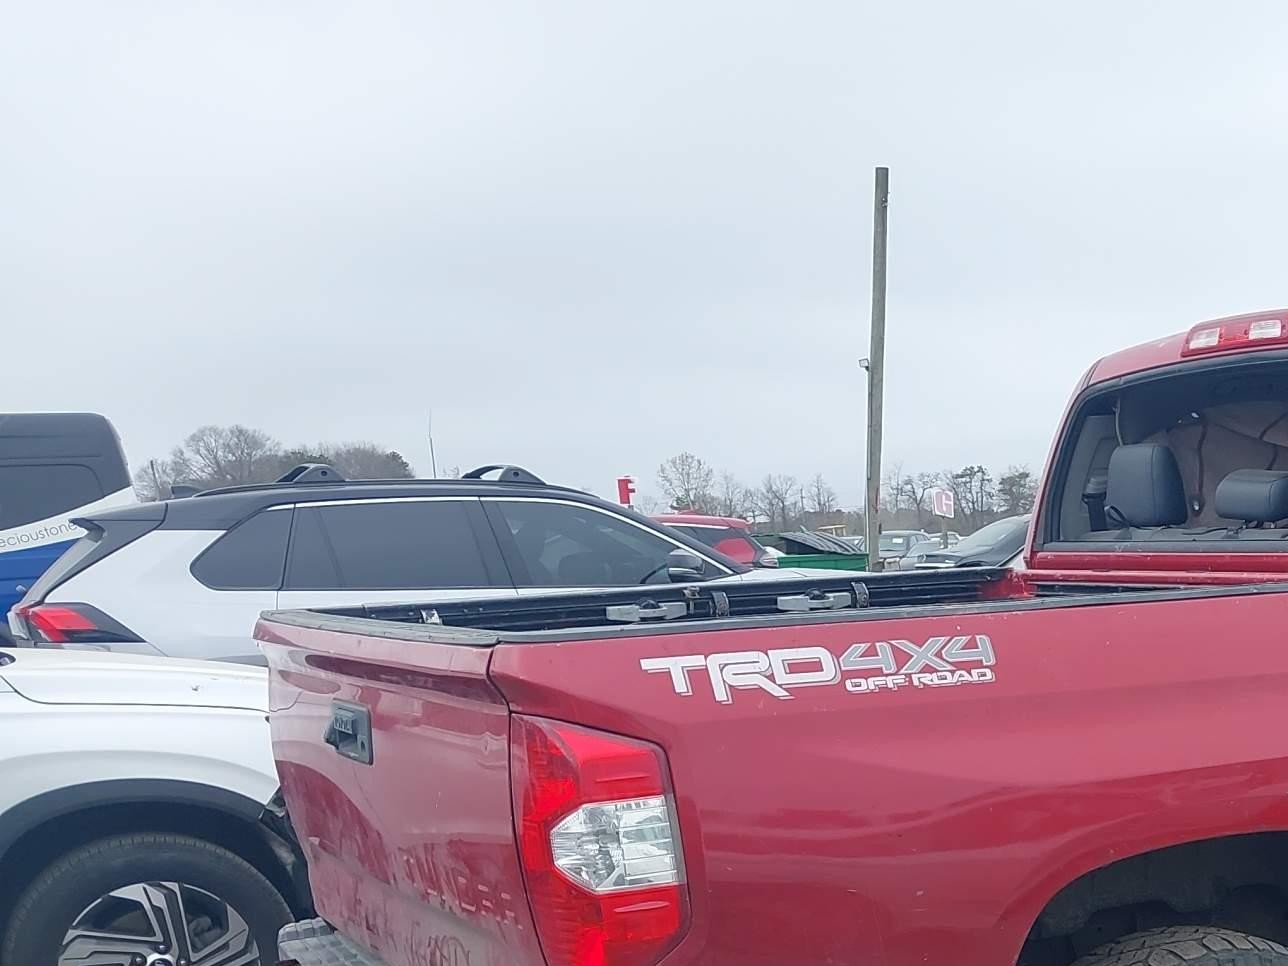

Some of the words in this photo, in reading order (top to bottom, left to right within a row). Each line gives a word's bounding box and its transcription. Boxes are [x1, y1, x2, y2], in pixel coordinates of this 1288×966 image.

[639, 646, 842, 705] TRD
[845, 675, 908, 693] OFF
[912, 667, 996, 688] ROAD
